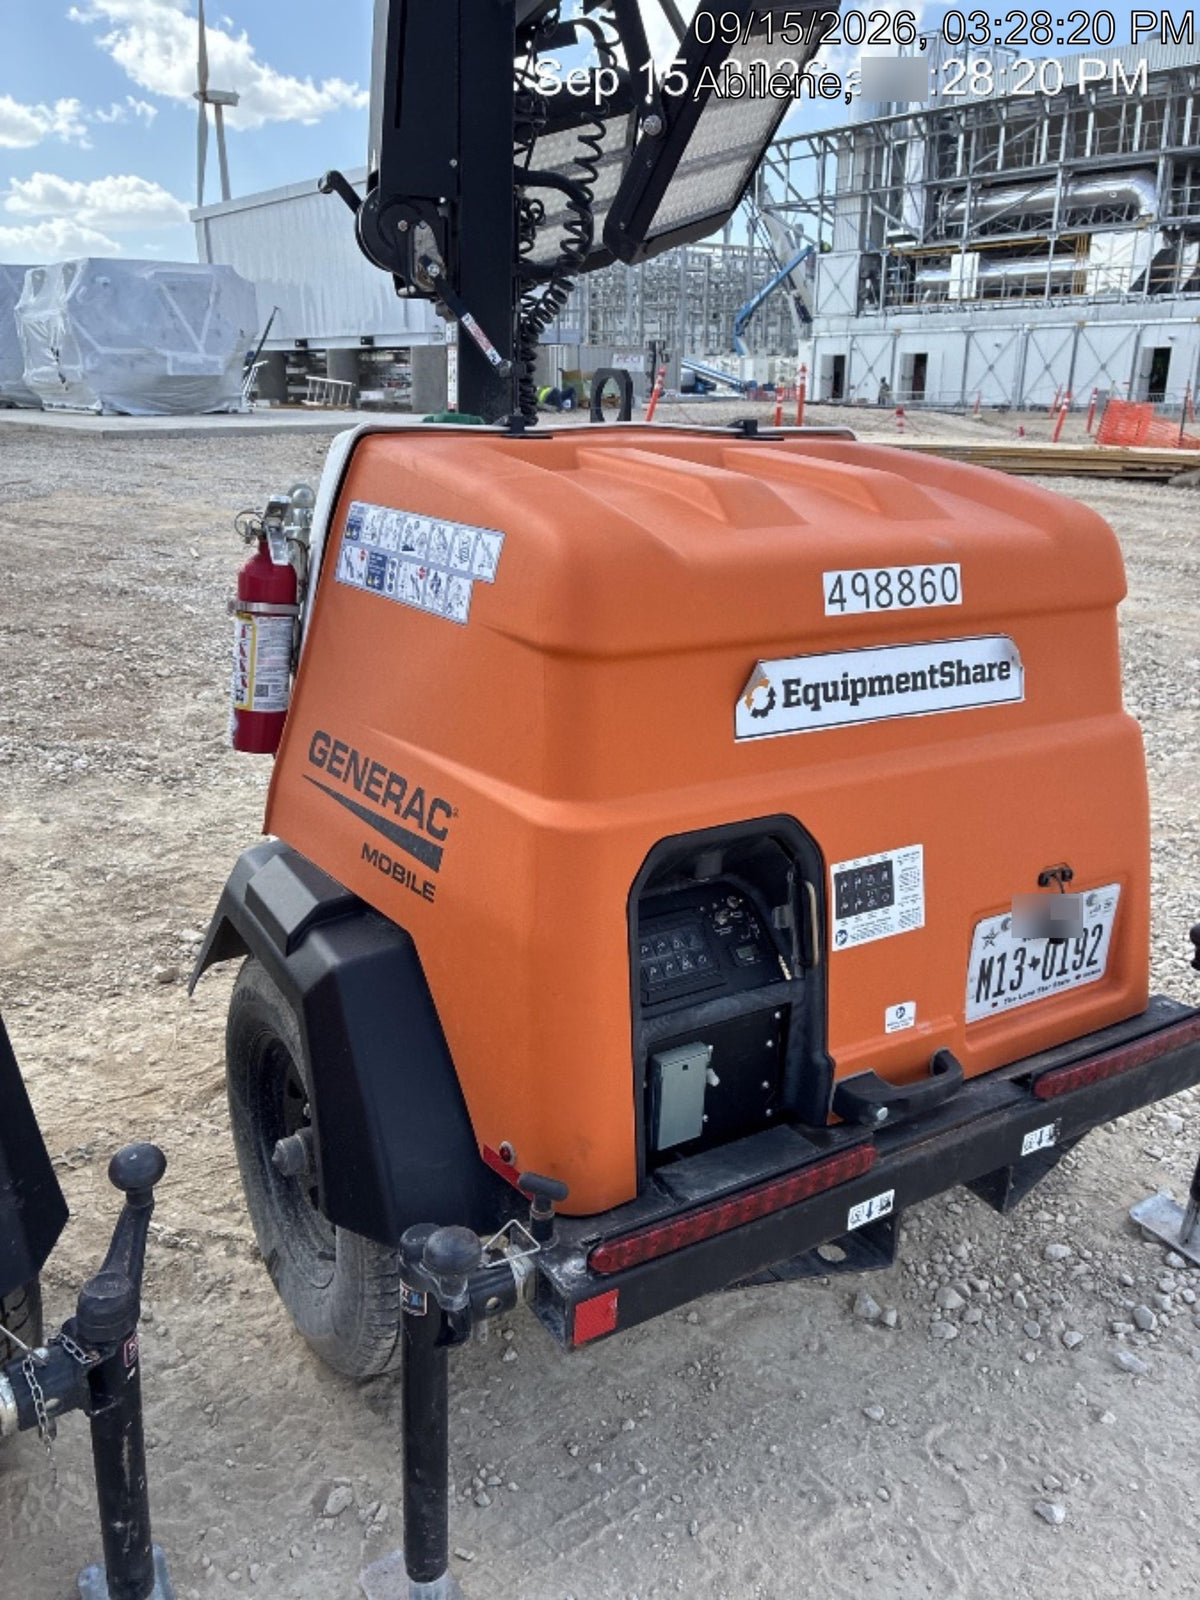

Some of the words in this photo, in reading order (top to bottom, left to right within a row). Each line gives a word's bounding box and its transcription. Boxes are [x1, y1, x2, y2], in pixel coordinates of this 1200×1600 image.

[828, 566, 958, 612] 498860
[782, 658, 1011, 712] EquipmentShare
[308, 730, 453, 842] GENERAC
[360, 842, 437, 904] MOBILE
